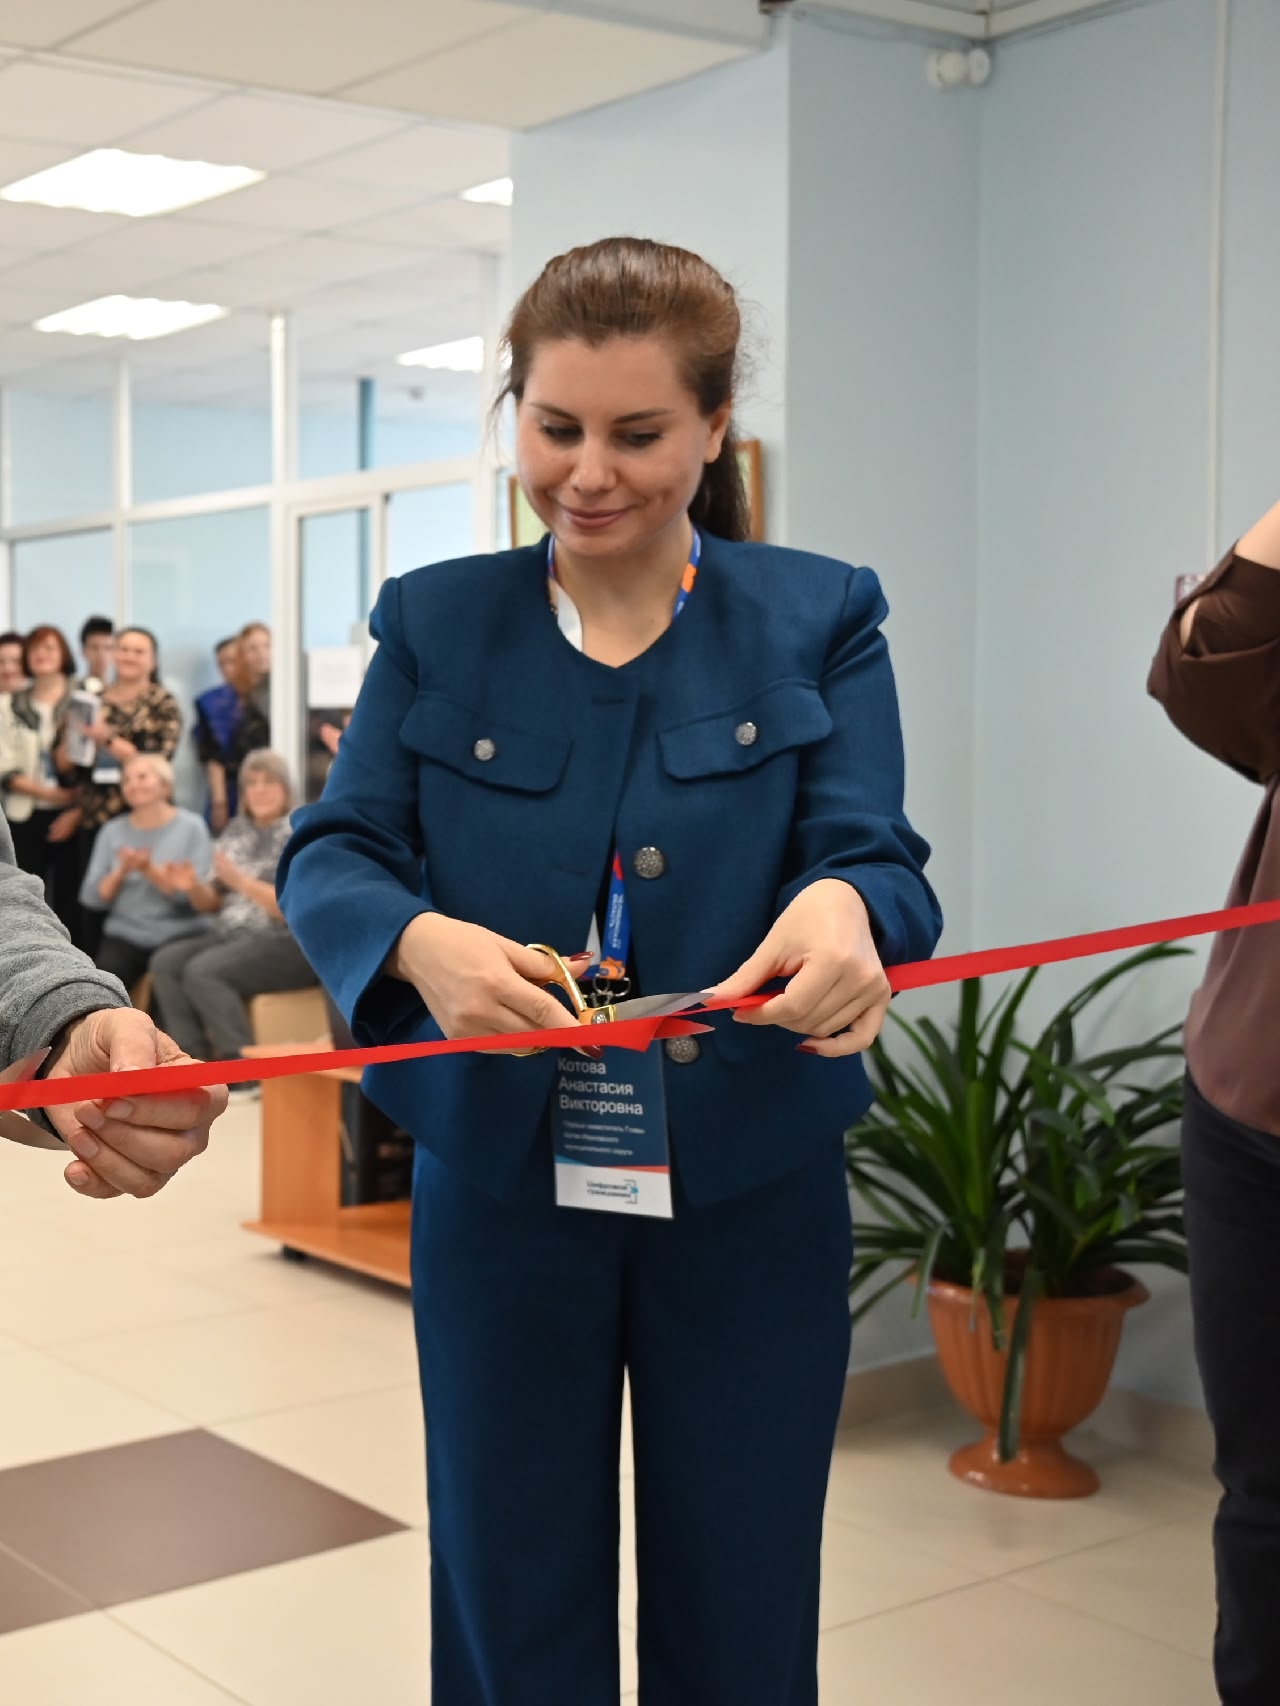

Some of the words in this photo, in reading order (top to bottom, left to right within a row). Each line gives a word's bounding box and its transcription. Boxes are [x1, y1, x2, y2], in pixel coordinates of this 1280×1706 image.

[558, 1058, 606, 1075] Котова
[559, 1076, 634, 1096] Анастасия
[559, 1094, 643, 1115] Викторовна
